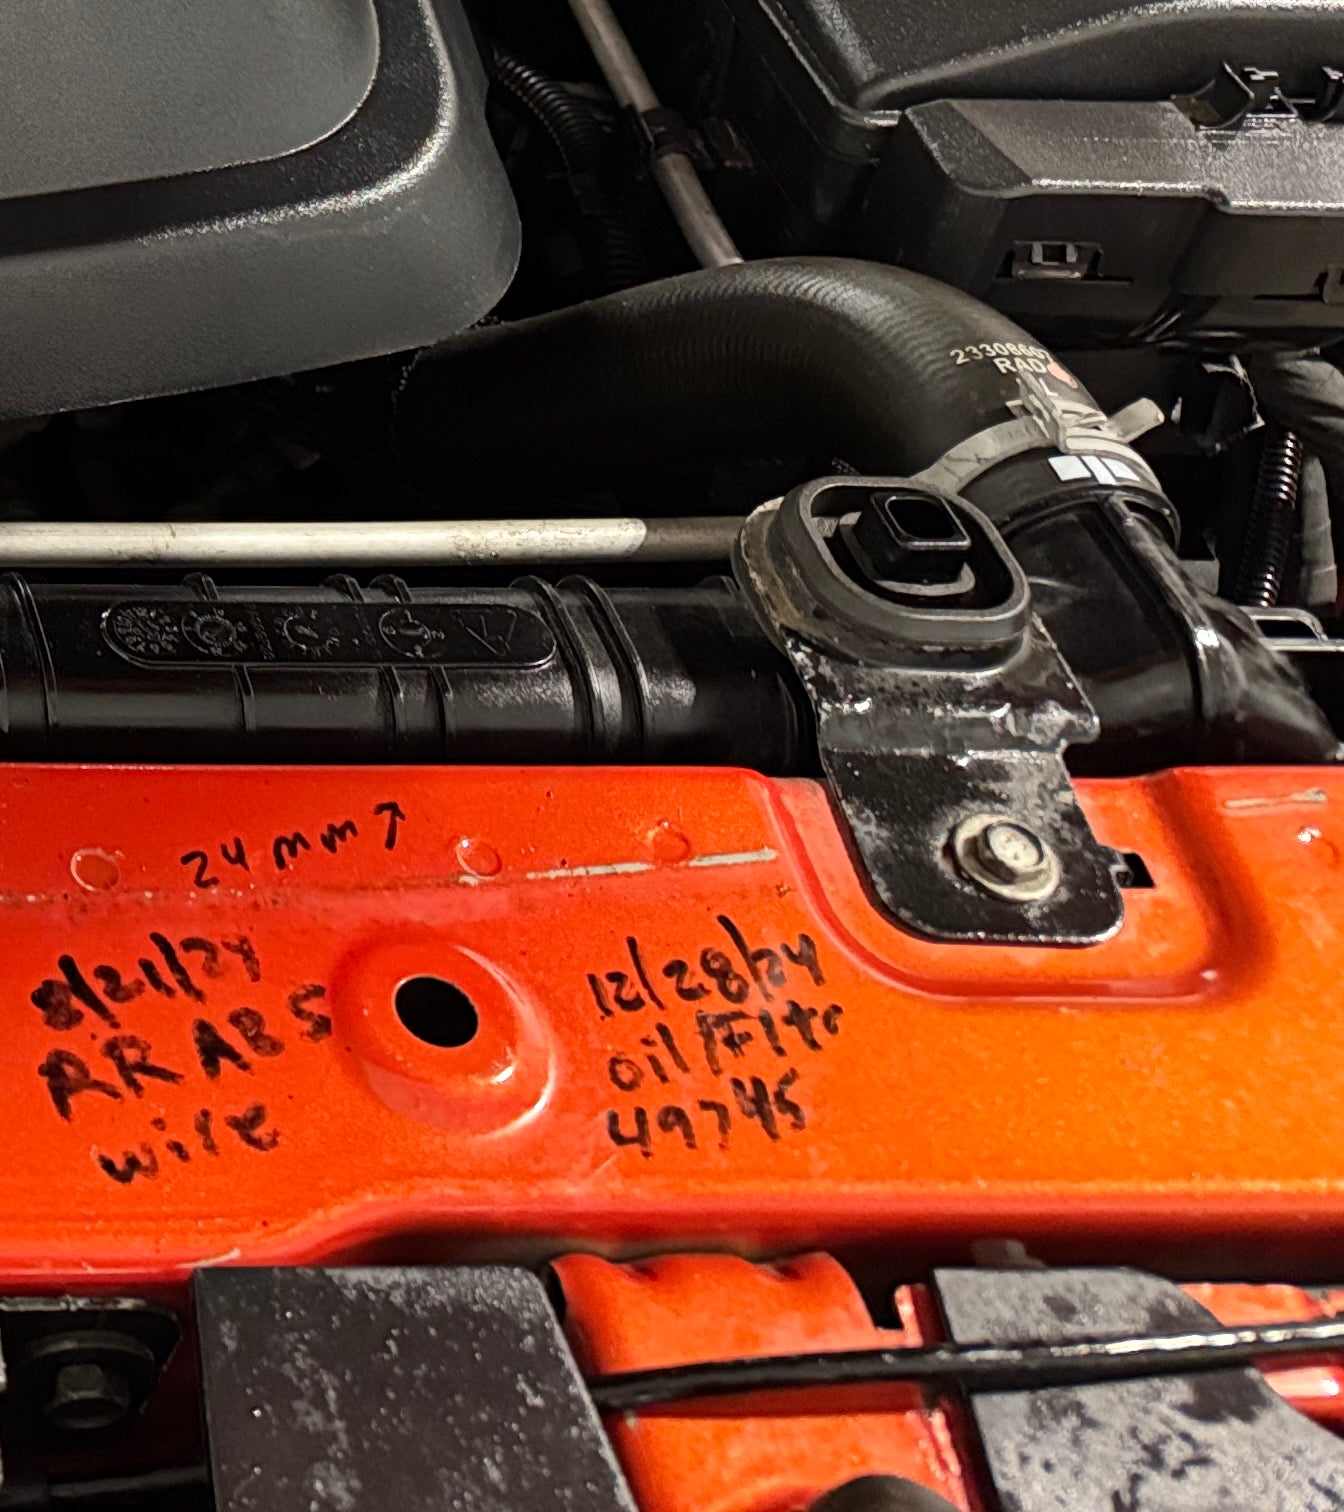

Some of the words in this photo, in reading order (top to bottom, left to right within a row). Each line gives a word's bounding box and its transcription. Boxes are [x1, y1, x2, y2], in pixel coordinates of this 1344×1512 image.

[993, 356, 1048, 375] RAD
[180, 836, 252, 888] 24
[272, 819, 359, 872] mm
[587, 913, 826, 1018] 12/28/24
[606, 1067, 807, 1159] 49745
